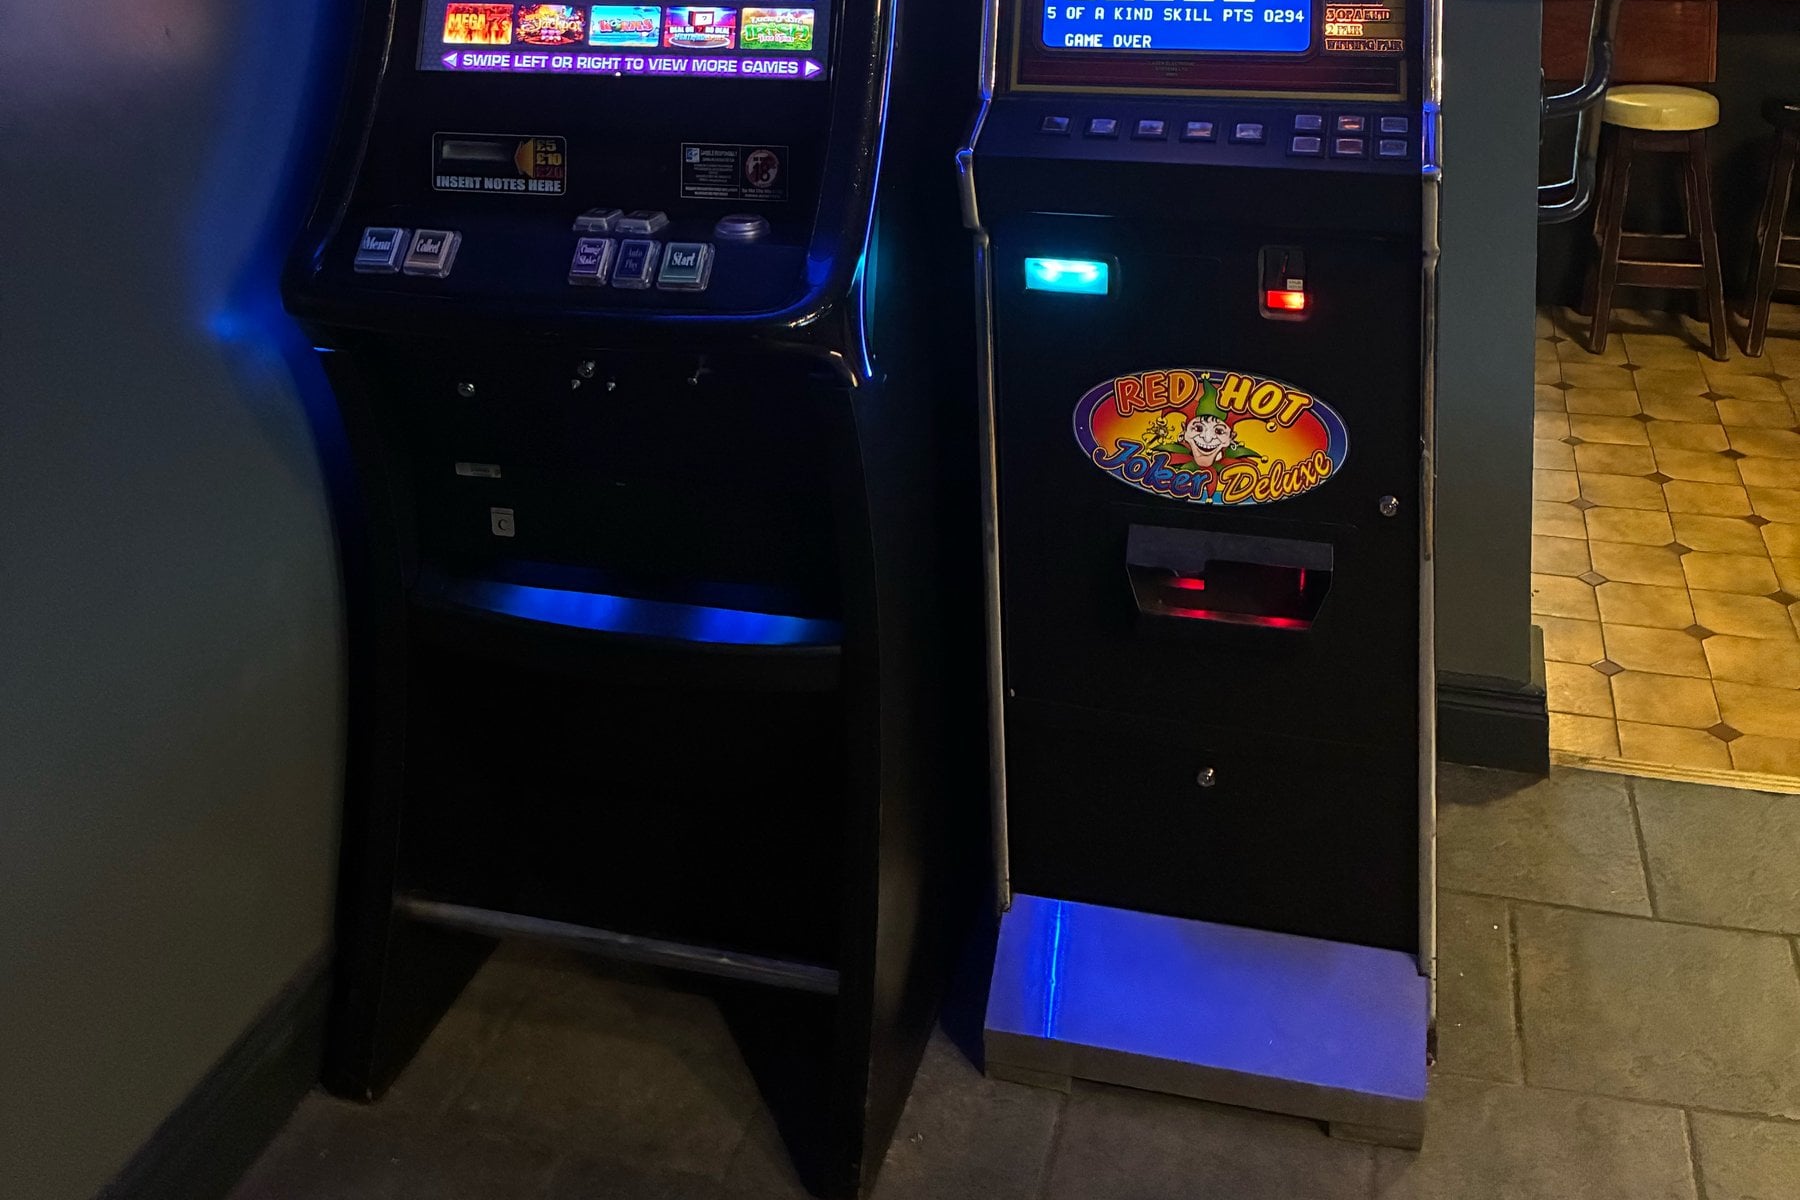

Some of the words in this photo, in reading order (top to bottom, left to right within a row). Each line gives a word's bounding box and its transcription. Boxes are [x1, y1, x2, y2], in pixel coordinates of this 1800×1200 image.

[448, 13, 486, 30] MEGA
[1047, 6, 1056, 19] 5
[1066, 7, 1085, 20] OF
[1094, 7, 1104, 20] A
[1114, 7, 1153, 21] KIND
[1163, 8, 1212, 22] SKILL
[1222, 9, 1253, 22] PTS
[1264, 9, 1304, 23] 0294
[1336, 8, 1353, 21] OF
[1354, 8, 1363, 21] A
[1325, 24, 1334, 35] 2
[1064, 33, 1103, 47] GAME
[1113, 34, 1152, 48] OVER
[463, 54, 510, 67] SWIPE
[514, 55, 548, 68] LEFT
[551, 56, 573, 69] OR
[576, 57, 621, 70] RIGHT
[624, 57, 644, 71] TO
[648, 58, 689, 72] VIEW
[691, 59, 738, 73] MORE
[742, 60, 799, 74] GAMES
[536, 152, 562, 165] £10
[436, 175, 482, 189] INSERT
[484, 177, 525, 190] NOTES
[528, 179, 562, 192] HERE
[363, 235, 392, 251] Menu
[671, 251, 696, 267] Start
[1113, 369, 1199, 417] RED
[1216, 370, 1315, 427] HOT
[1092, 438, 1211, 500] Joker
[1219, 450, 1333, 505] Deluxe
